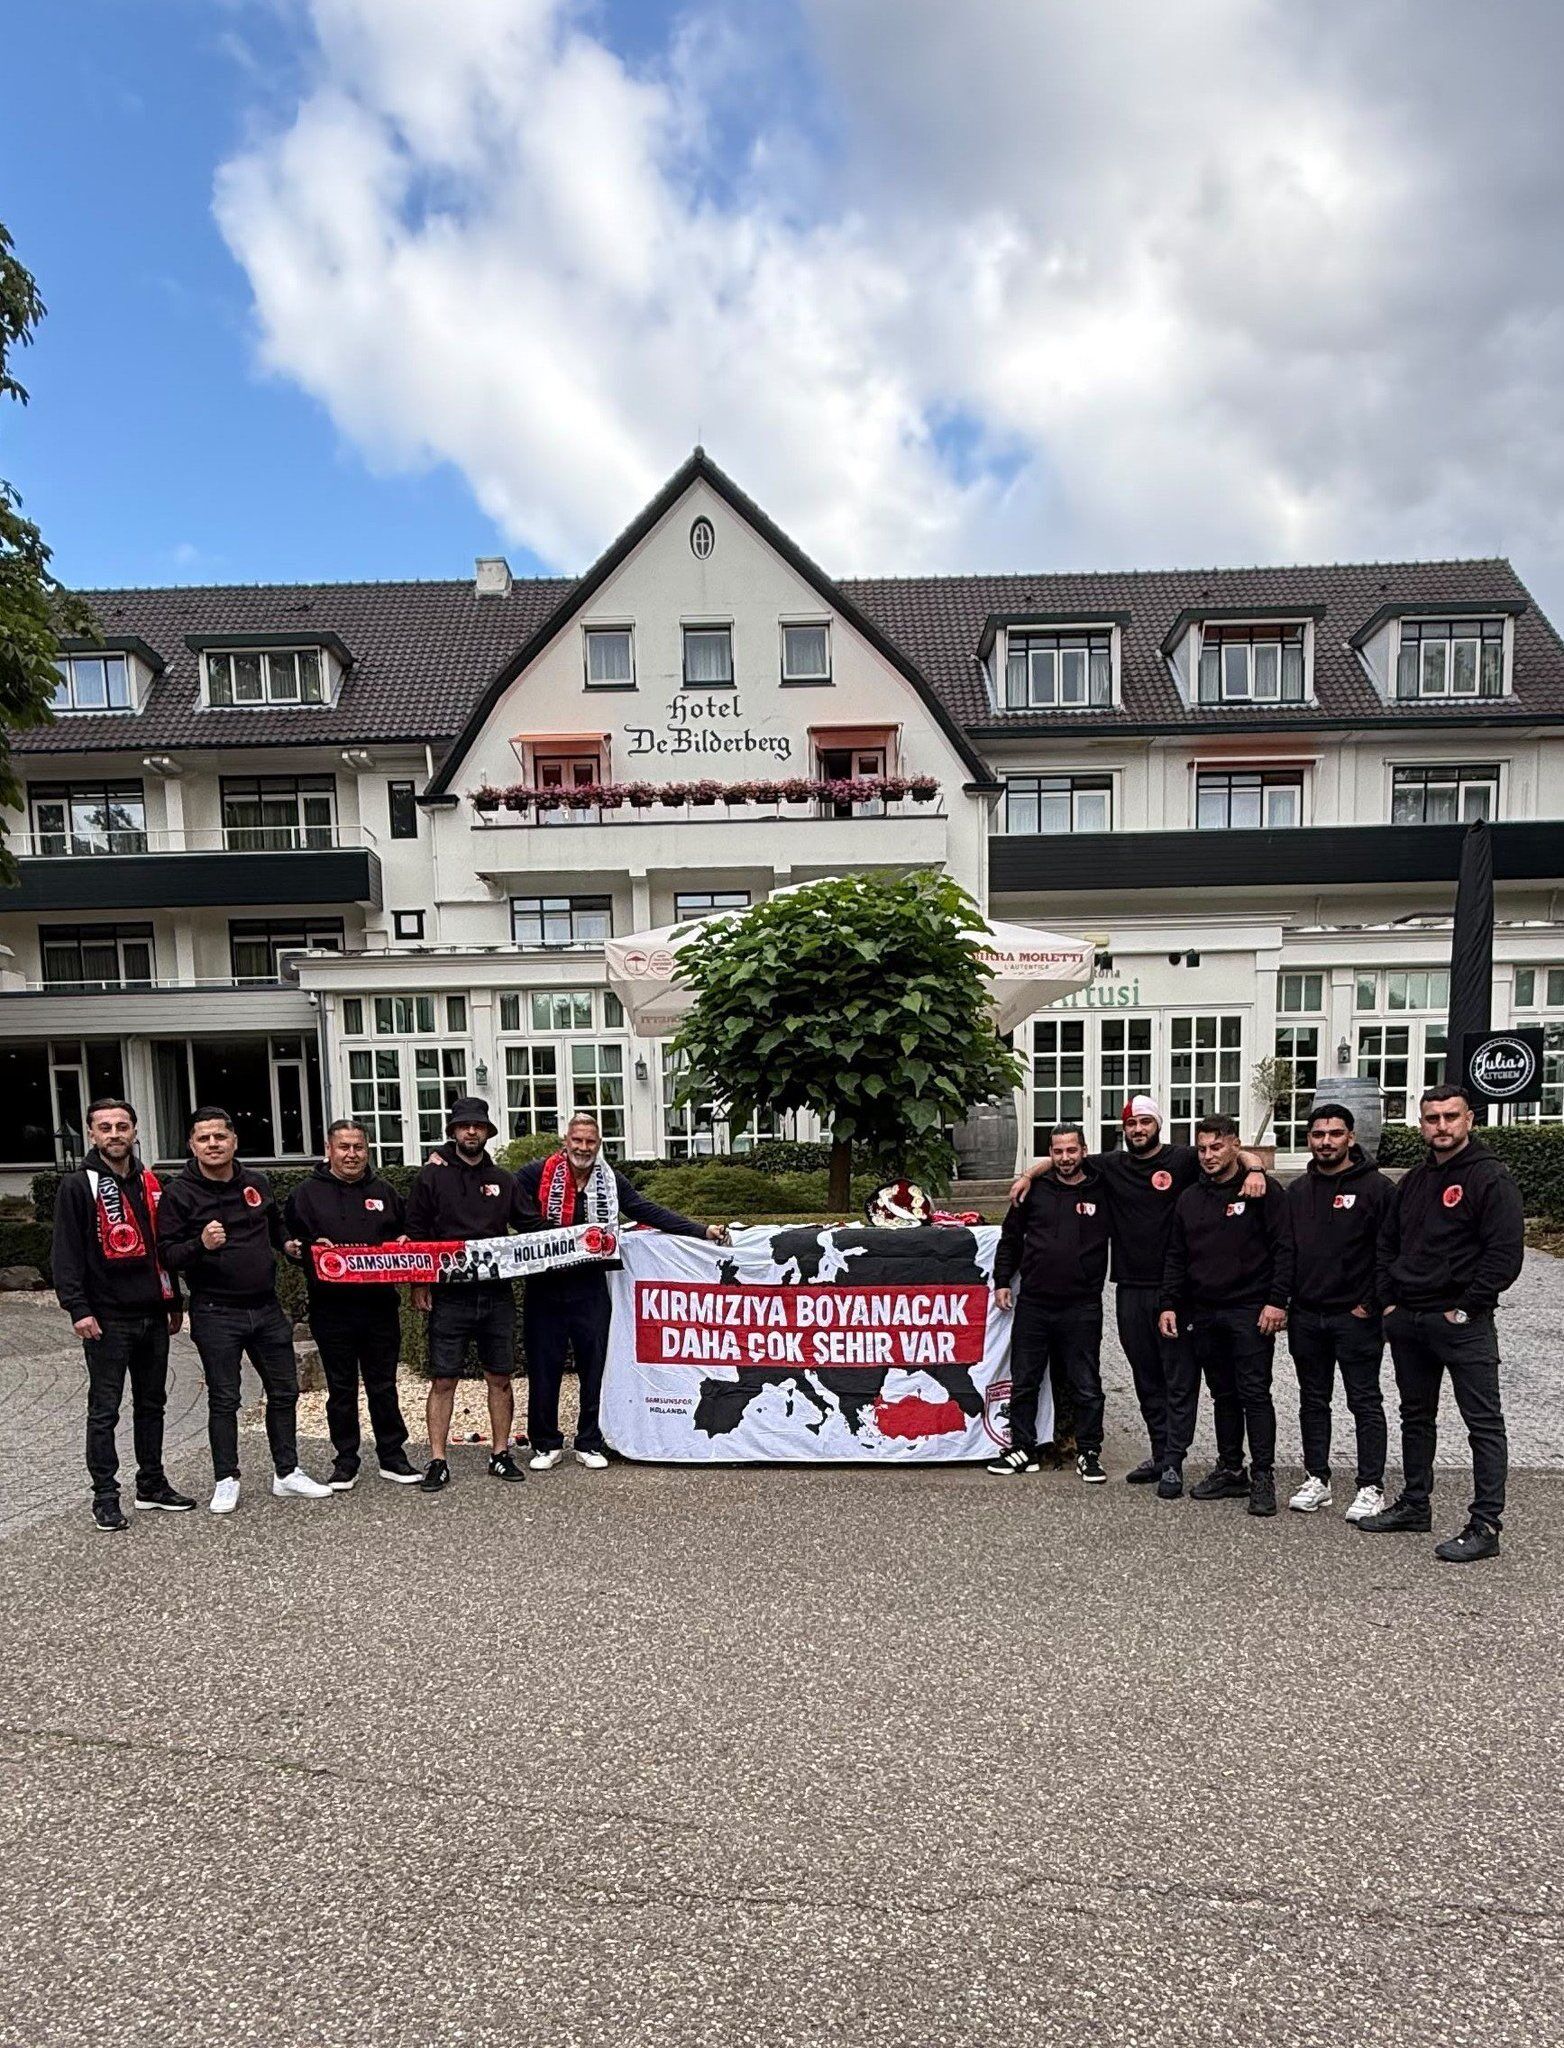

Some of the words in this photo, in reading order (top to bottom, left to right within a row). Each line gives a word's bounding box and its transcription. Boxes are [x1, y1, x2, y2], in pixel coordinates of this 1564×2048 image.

[666, 695, 743, 725] Hotel
[1019, 952, 1084, 963] MORETTI
[1475, 1052, 1525, 1078] Julia's
[346, 1254, 433, 1271] SAMSUNSPOR
[514, 1238, 576, 1264] HOLLANDA
[642, 1288, 787, 1327] KIRMIZIYA
[796, 1294, 969, 1328] BOYANACAK
[661, 1327, 742, 1362] DAHA
[747, 1330, 805, 1365] ÇOK
[899, 1331, 956, 1364] VAR
